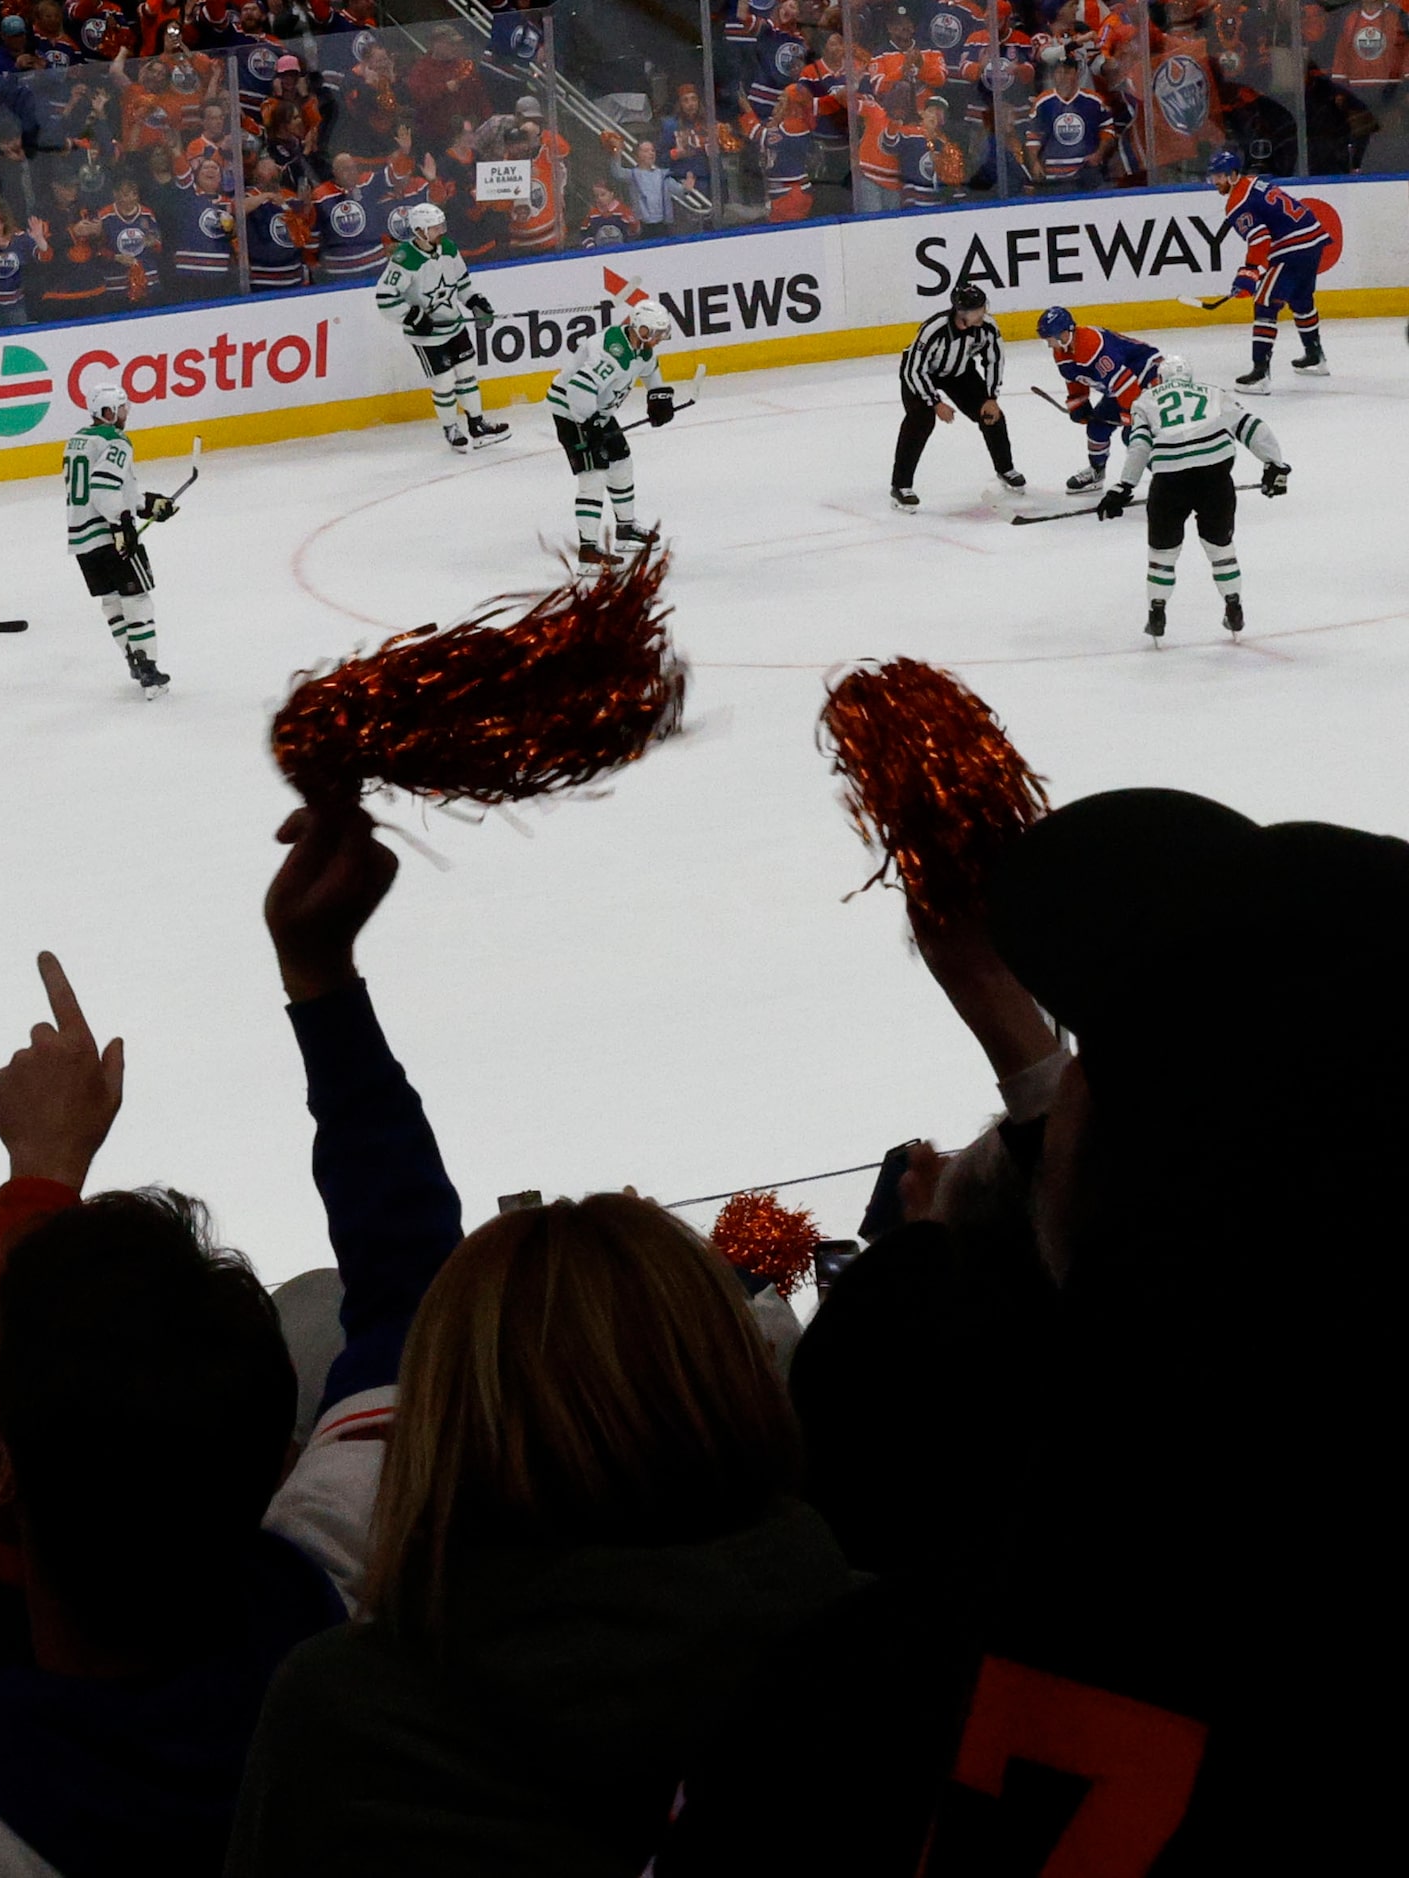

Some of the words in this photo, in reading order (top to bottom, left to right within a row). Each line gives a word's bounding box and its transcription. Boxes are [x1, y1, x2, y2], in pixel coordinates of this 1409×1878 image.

[490, 167, 517, 176] PLAY
[915, 215, 1231, 297] SAFEWAY
[383, 270, 402, 286] 18
[658, 272, 822, 338] NEWS
[67, 319, 329, 411] Castrol
[592, 360, 615, 380] 12
[1157, 390, 1208, 428] 27
[106, 445, 128, 470] 20
